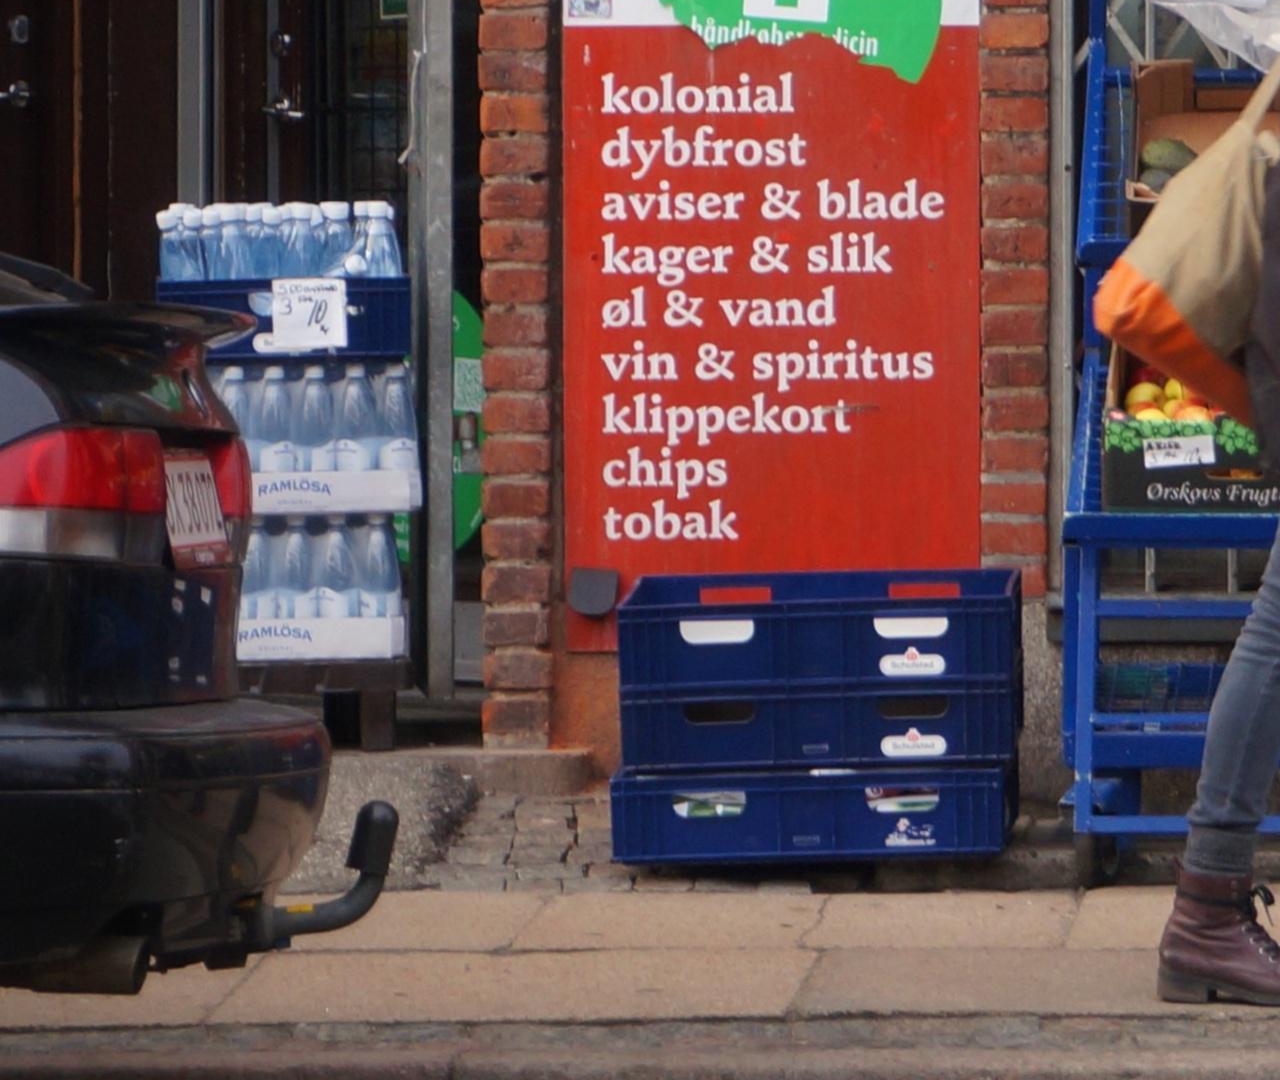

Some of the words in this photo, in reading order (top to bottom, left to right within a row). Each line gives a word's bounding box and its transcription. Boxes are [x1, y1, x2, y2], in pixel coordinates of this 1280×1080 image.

[600, 72, 795, 113] kolonial
[600, 126, 806, 179] dybfrost
[600, 180, 745, 220] aviser
[761, 183, 801, 220] &
[816, 178, 946, 220] blade
[600, 232, 734, 287] kager
[750, 235, 790, 274] &
[807, 231, 894, 274] slik
[600, 286, 647, 329] øl
[663, 289, 704, 328] &
[718, 285, 837, 328] vand
[600, 340, 679, 381] vin
[694, 342, 735, 381] &
[752, 339, 936, 392] spiritus
[601, 394, 852, 446] klippekort
[258, 477, 332, 497] RAMLÖSA
[602, 447, 729, 500] chips
[1147, 481, 1220, 504] Ørskovs
[603, 499, 739, 541] tobak
[238, 624, 312, 642] RAMLÖSA
